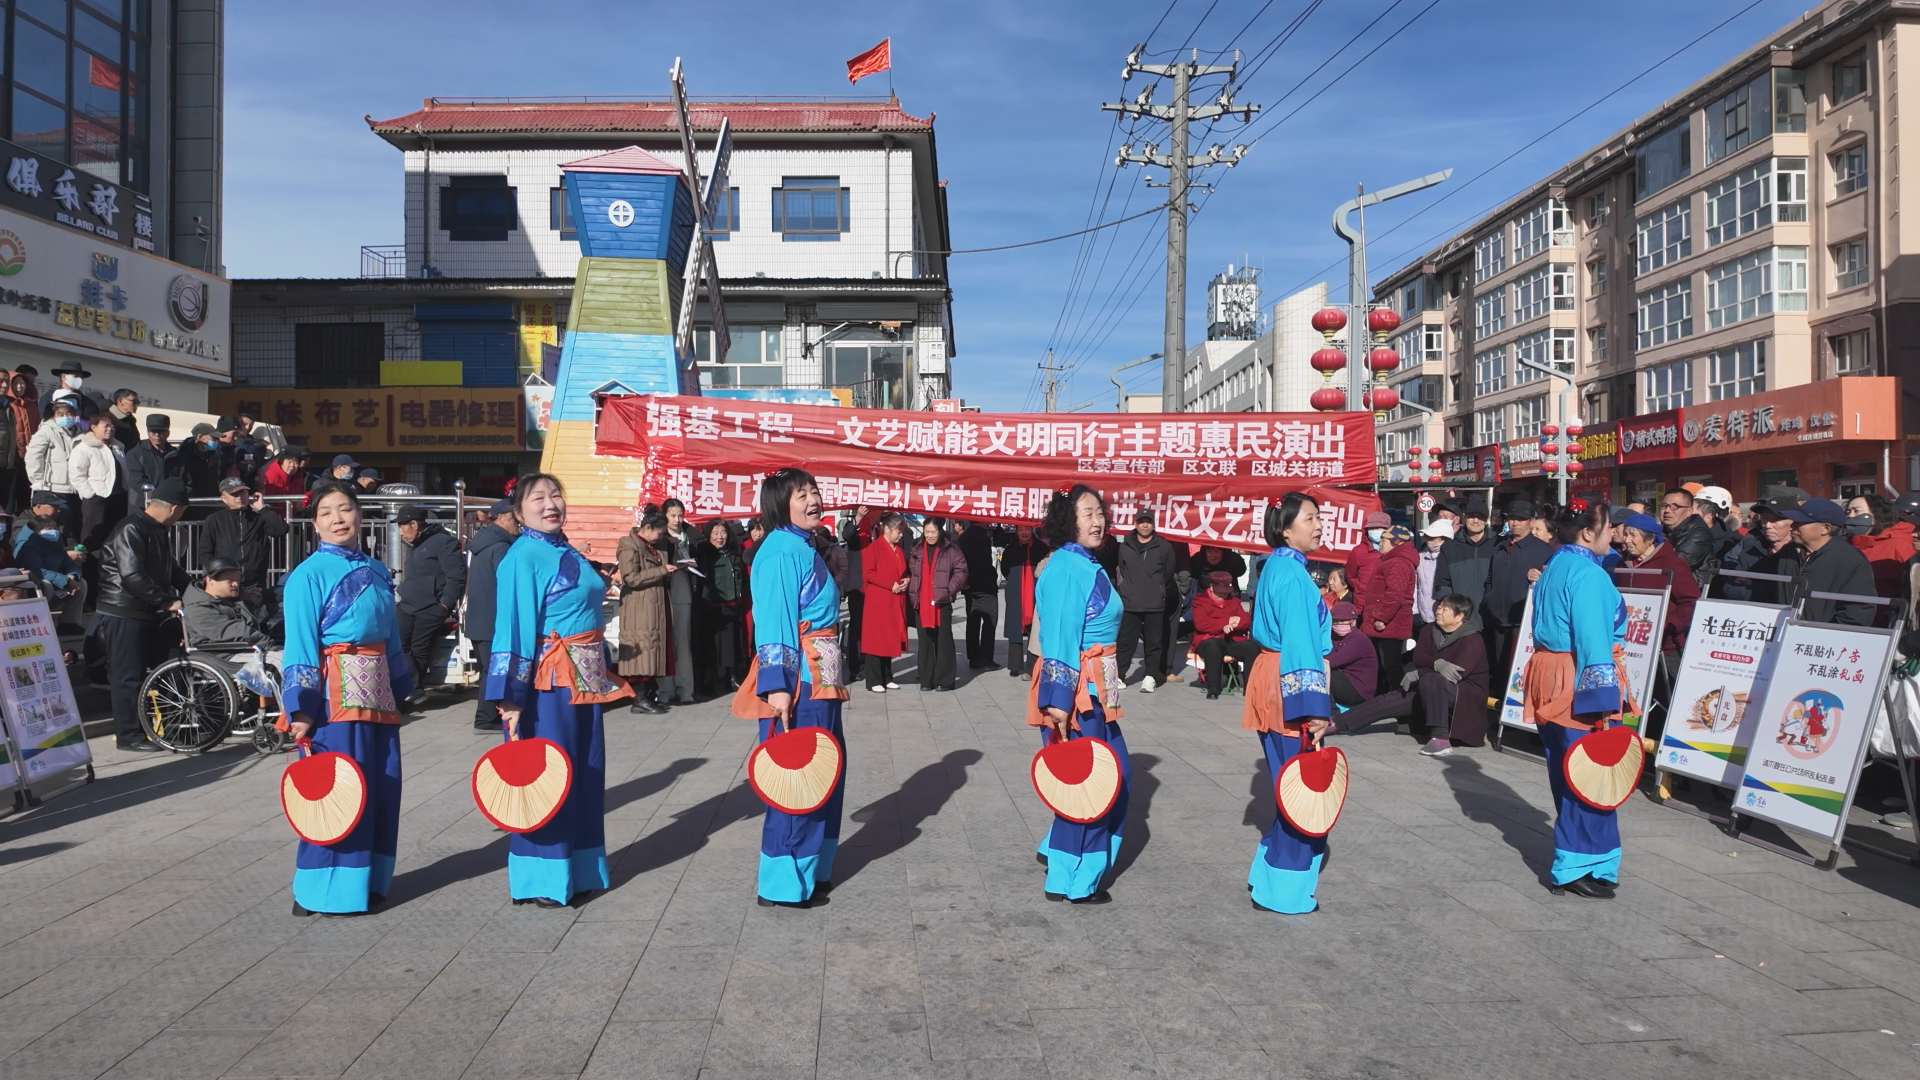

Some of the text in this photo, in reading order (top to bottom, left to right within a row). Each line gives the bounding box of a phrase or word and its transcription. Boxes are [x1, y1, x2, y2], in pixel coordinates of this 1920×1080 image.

[7, 157, 120, 226] 俱乐部
[57, 212, 119, 241] BILLARD CLUB
[134, 194, 152, 239] 二楼
[56, 300, 148, 344] 益智手工坊
[400, 399, 516, 428] 电器修理
[1704, 405, 1776, 442] 麦特派
[1780, 412, 1834, 431] 炸鸡 汉堡
[1077, 459, 1344, 478] 区委宣传部 区文联 区城关街道
[1421, 499, 1432, 508] 50
[1702, 616, 1777, 643] 光盘行动
